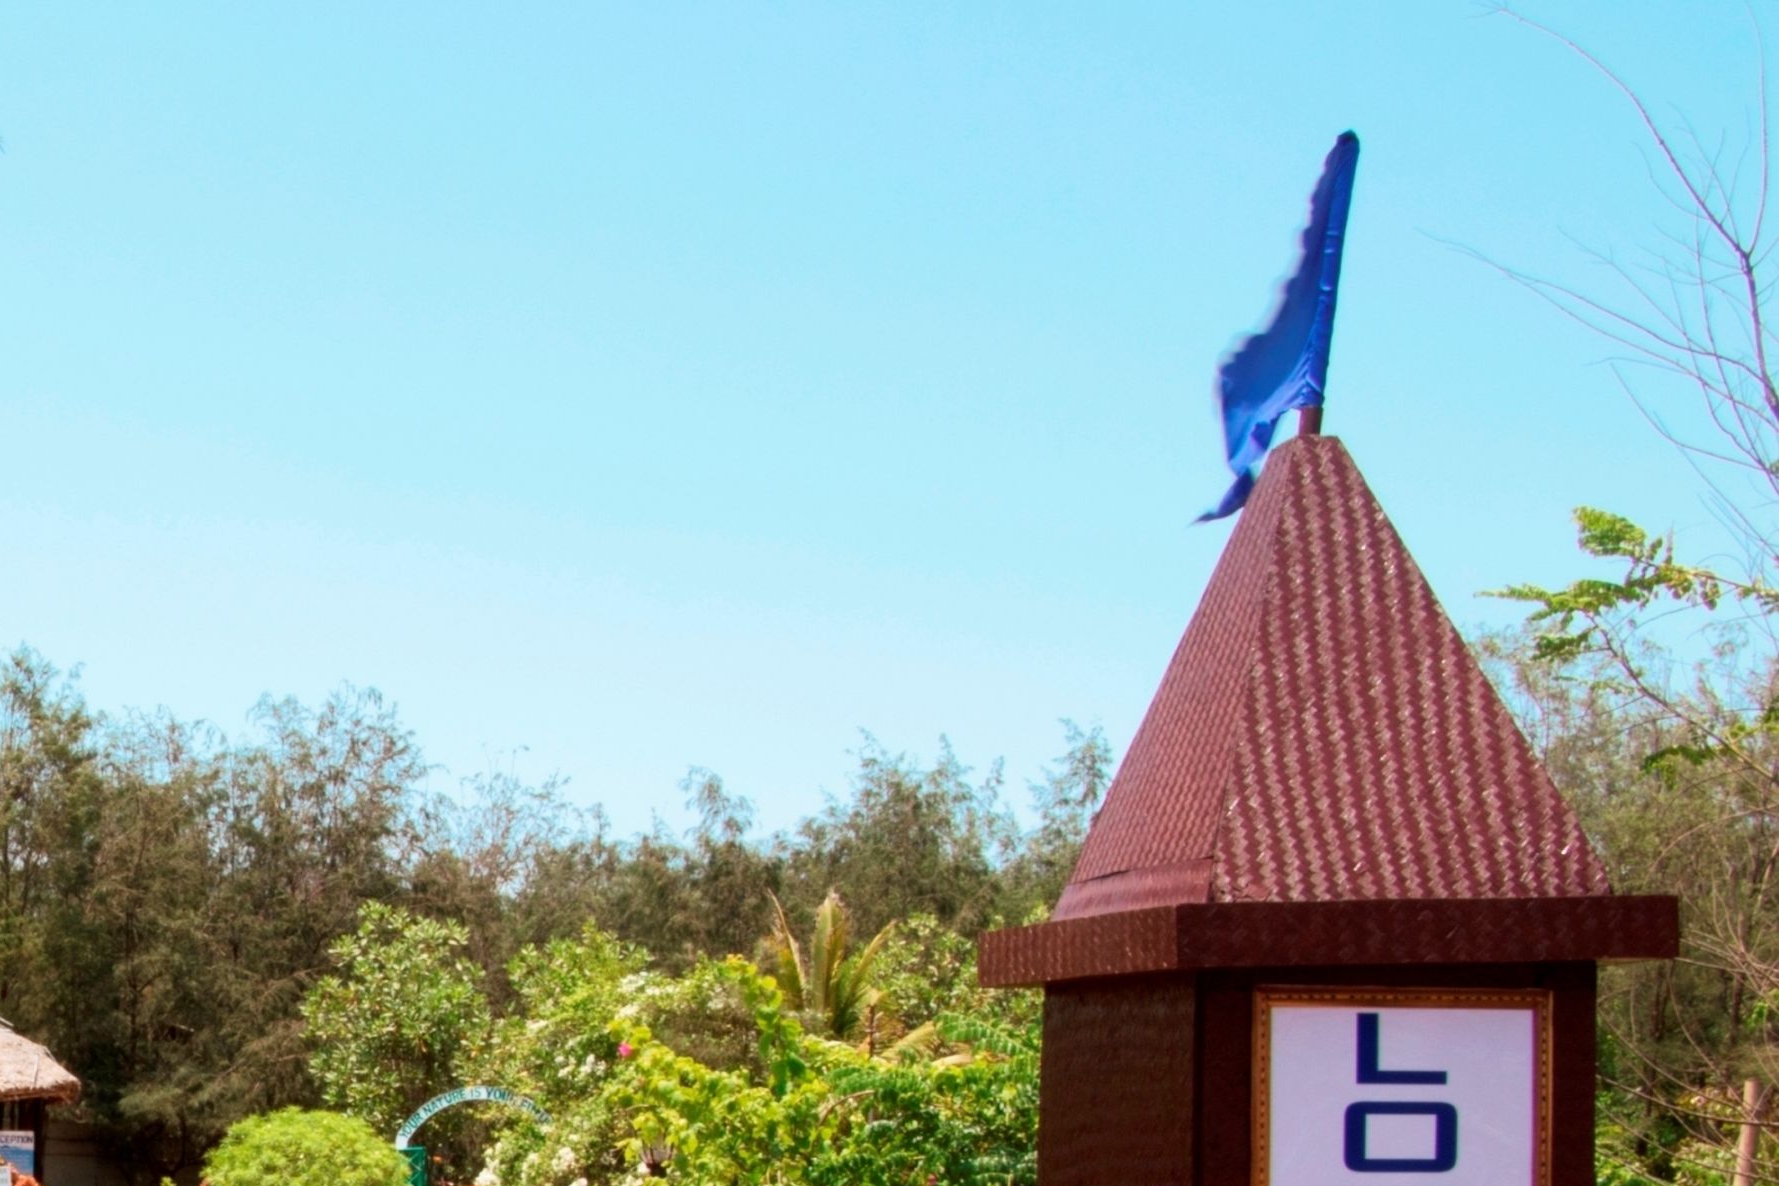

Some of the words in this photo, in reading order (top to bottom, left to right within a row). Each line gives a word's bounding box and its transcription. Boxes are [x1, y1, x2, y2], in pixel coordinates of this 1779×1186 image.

[400, 1114, 424, 1138] YOUR
[423, 1090, 467, 1115] NATURE
[470, 1089, 481, 1098] IS
